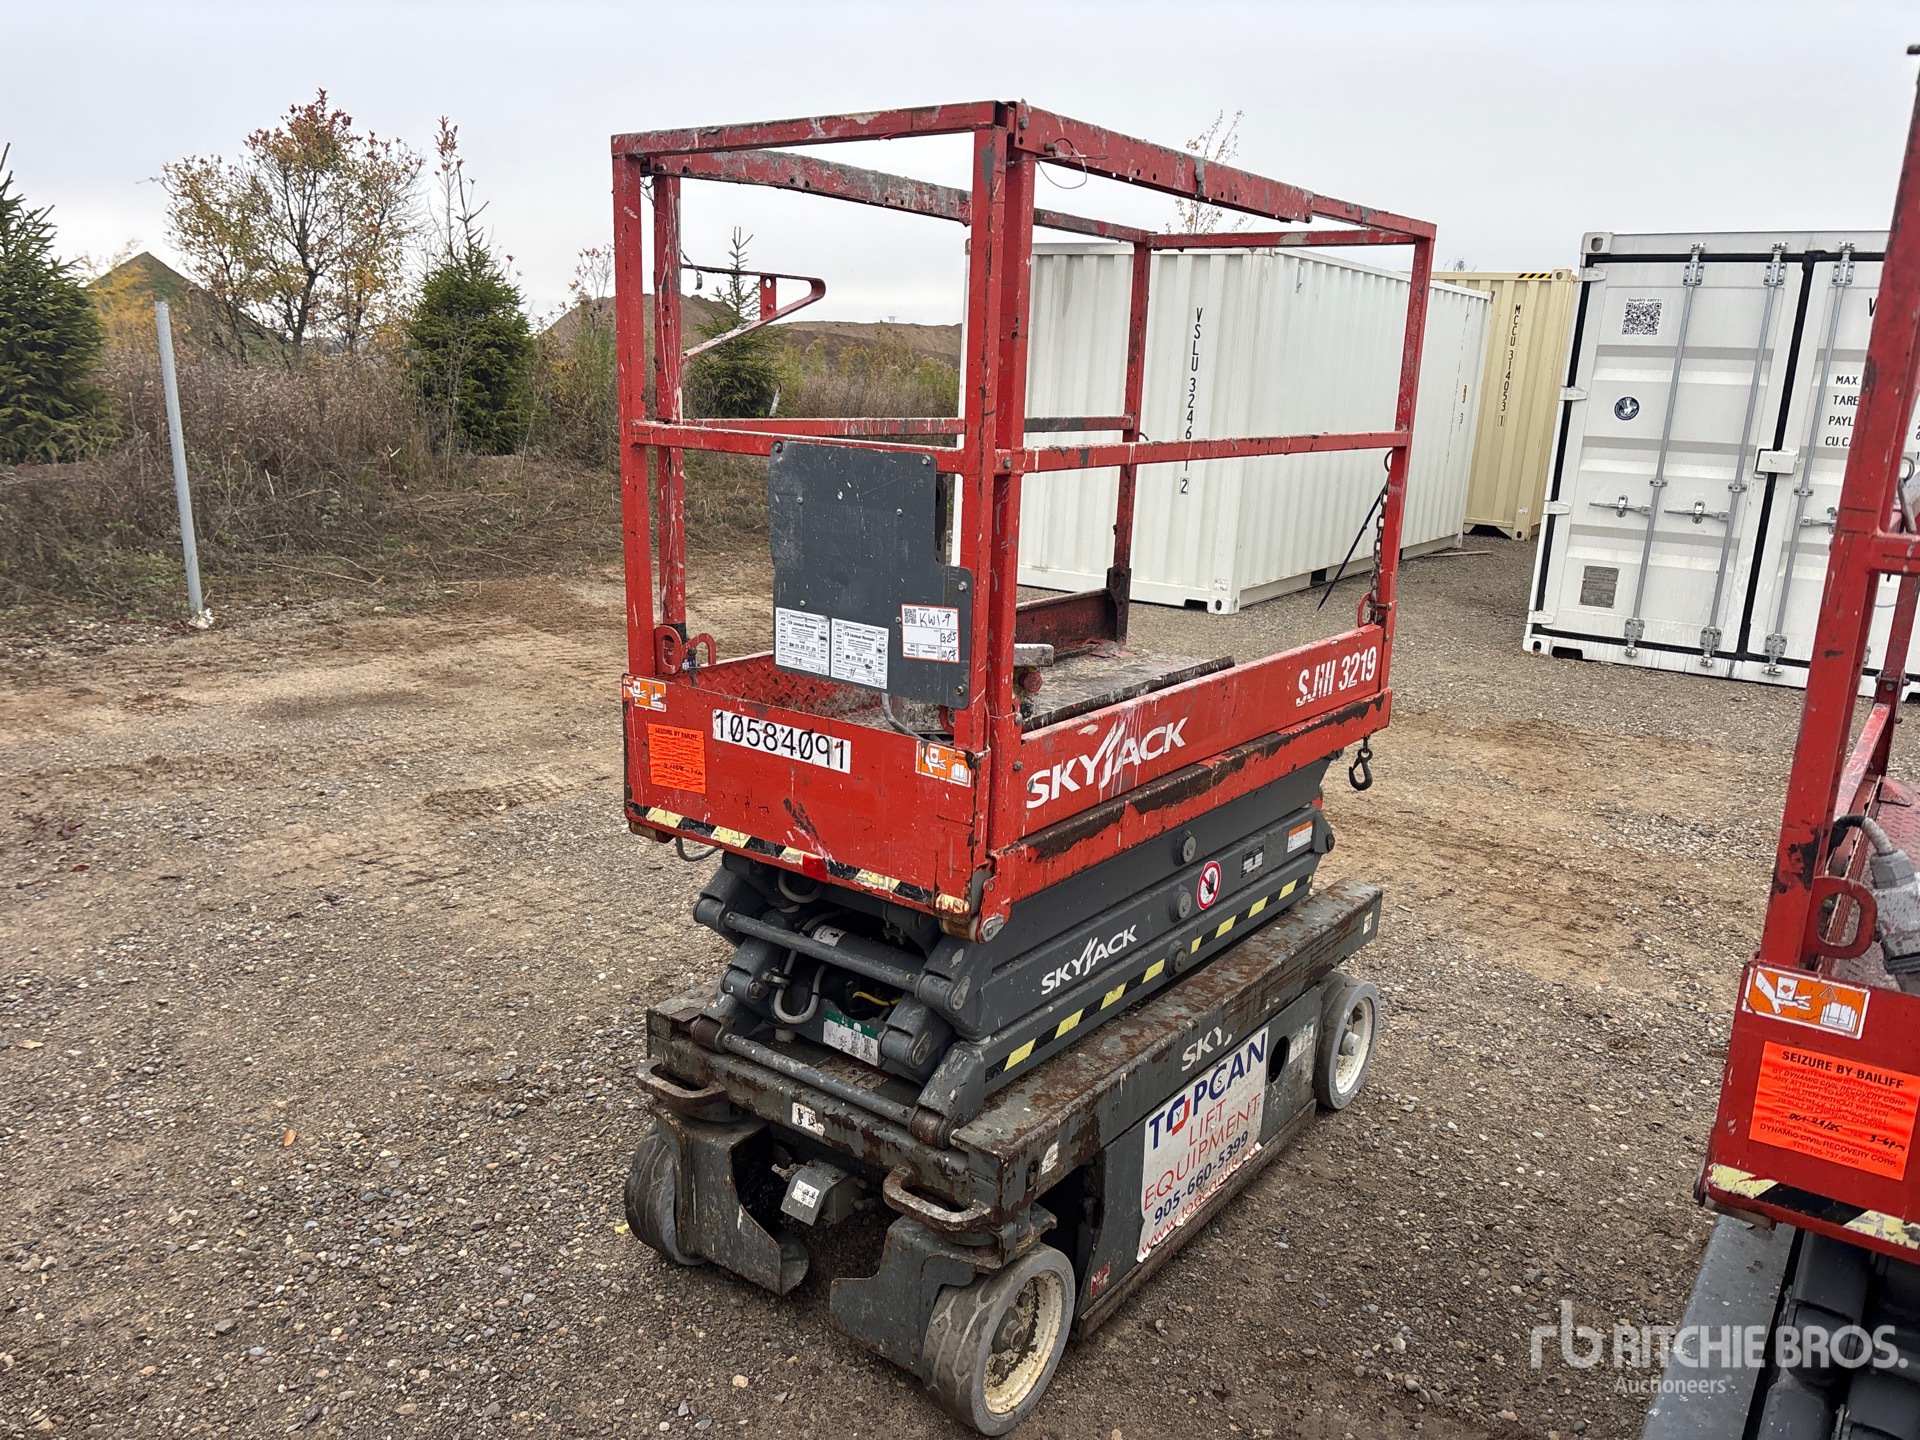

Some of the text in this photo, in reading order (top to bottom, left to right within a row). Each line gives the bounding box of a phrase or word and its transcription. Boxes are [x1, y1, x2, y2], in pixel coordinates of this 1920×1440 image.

[1191, 307, 1202, 372] VSLU
[1510, 304, 1521, 346] MCCU
[1501, 350, 1514, 411] 314053
[1836, 376, 1860, 386] MAX.
[1185, 377, 1196, 471] 32461
[1826, 436, 1851, 446] CU.C
[1828, 416, 1854, 426] PAYL
[1338, 646, 1376, 690] 3219
[716, 711, 844, 769] 10584091
[1027, 717, 1188, 808] SKYJACK
[1041, 924, 1138, 996] SKYJACK
[1149, 1032, 1266, 1149] TOPCAN
[1781, 1050, 1904, 1089] SEIZURE BY BAILIFF
[1188, 1098, 1226, 1147] LIFT
[1759, 1123, 1897, 1167] DYNAMIC CIVIL RECOVERY CORP.
[1144, 1093, 1261, 1211] EQUIPMENT
[1154, 1130, 1248, 1226] 905-660-5399
